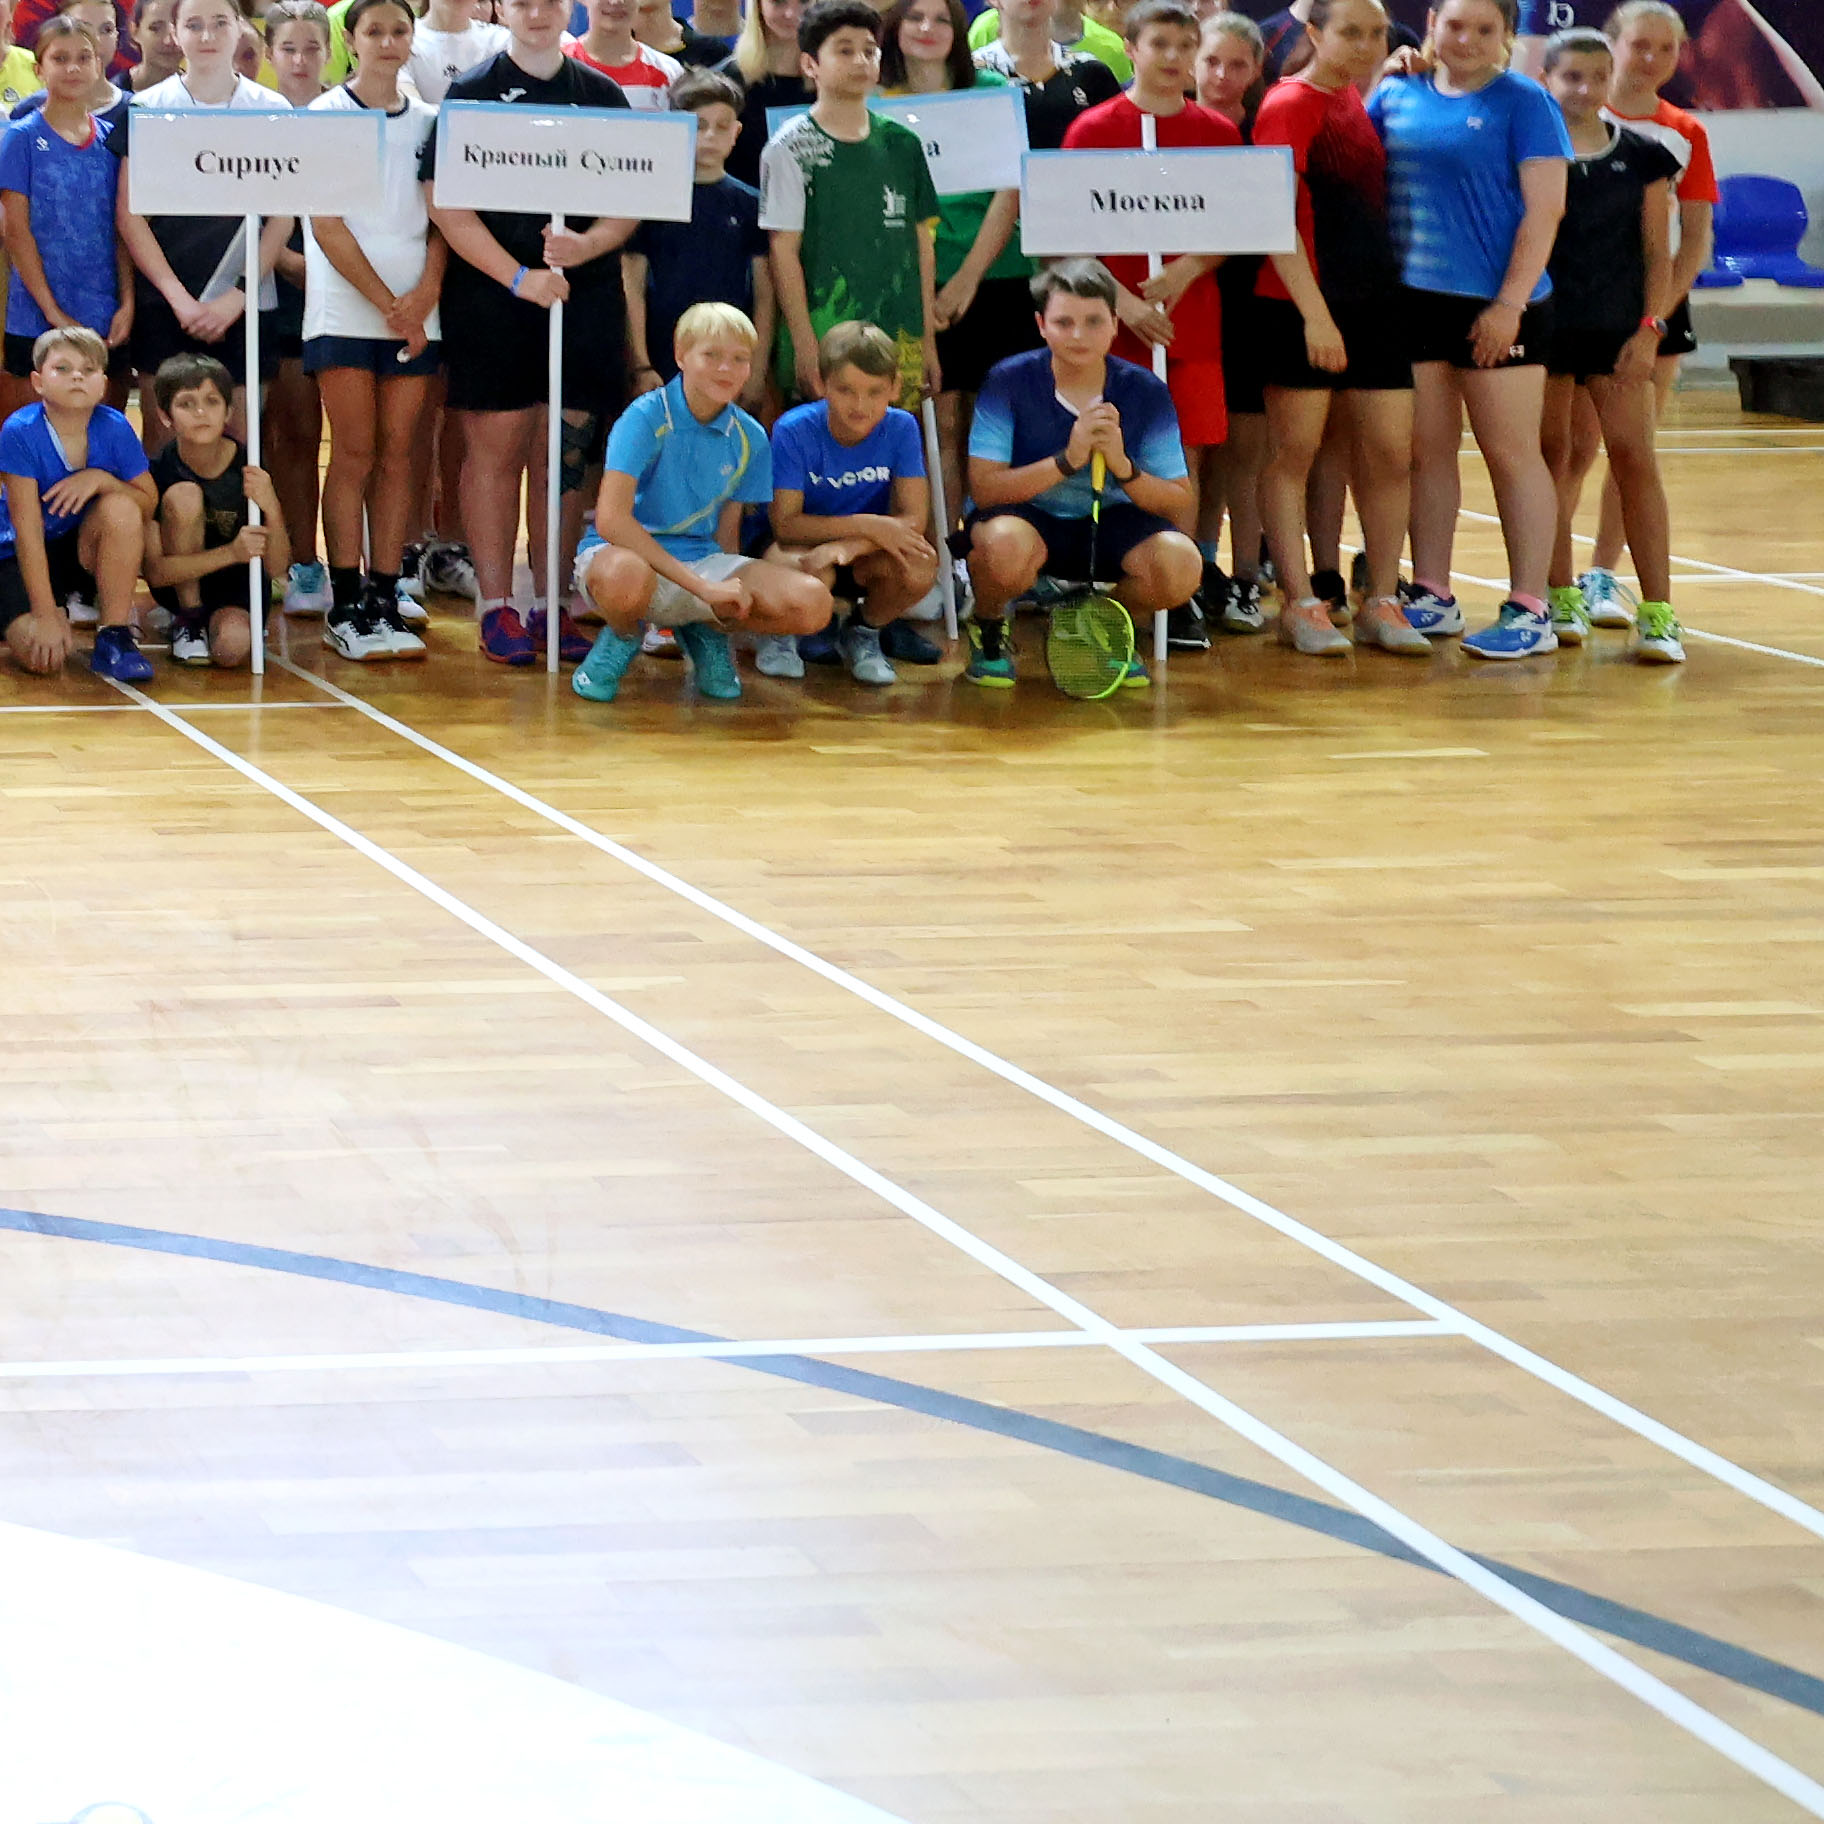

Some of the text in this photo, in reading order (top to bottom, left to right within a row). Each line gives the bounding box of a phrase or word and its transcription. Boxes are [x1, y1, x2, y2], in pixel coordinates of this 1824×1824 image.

[193, 149, 301, 181] Сириус
[463, 142, 654, 175] Красный Сулин
[1089, 188, 1207, 214] Москва
[826, 466, 892, 490] VCTOR
